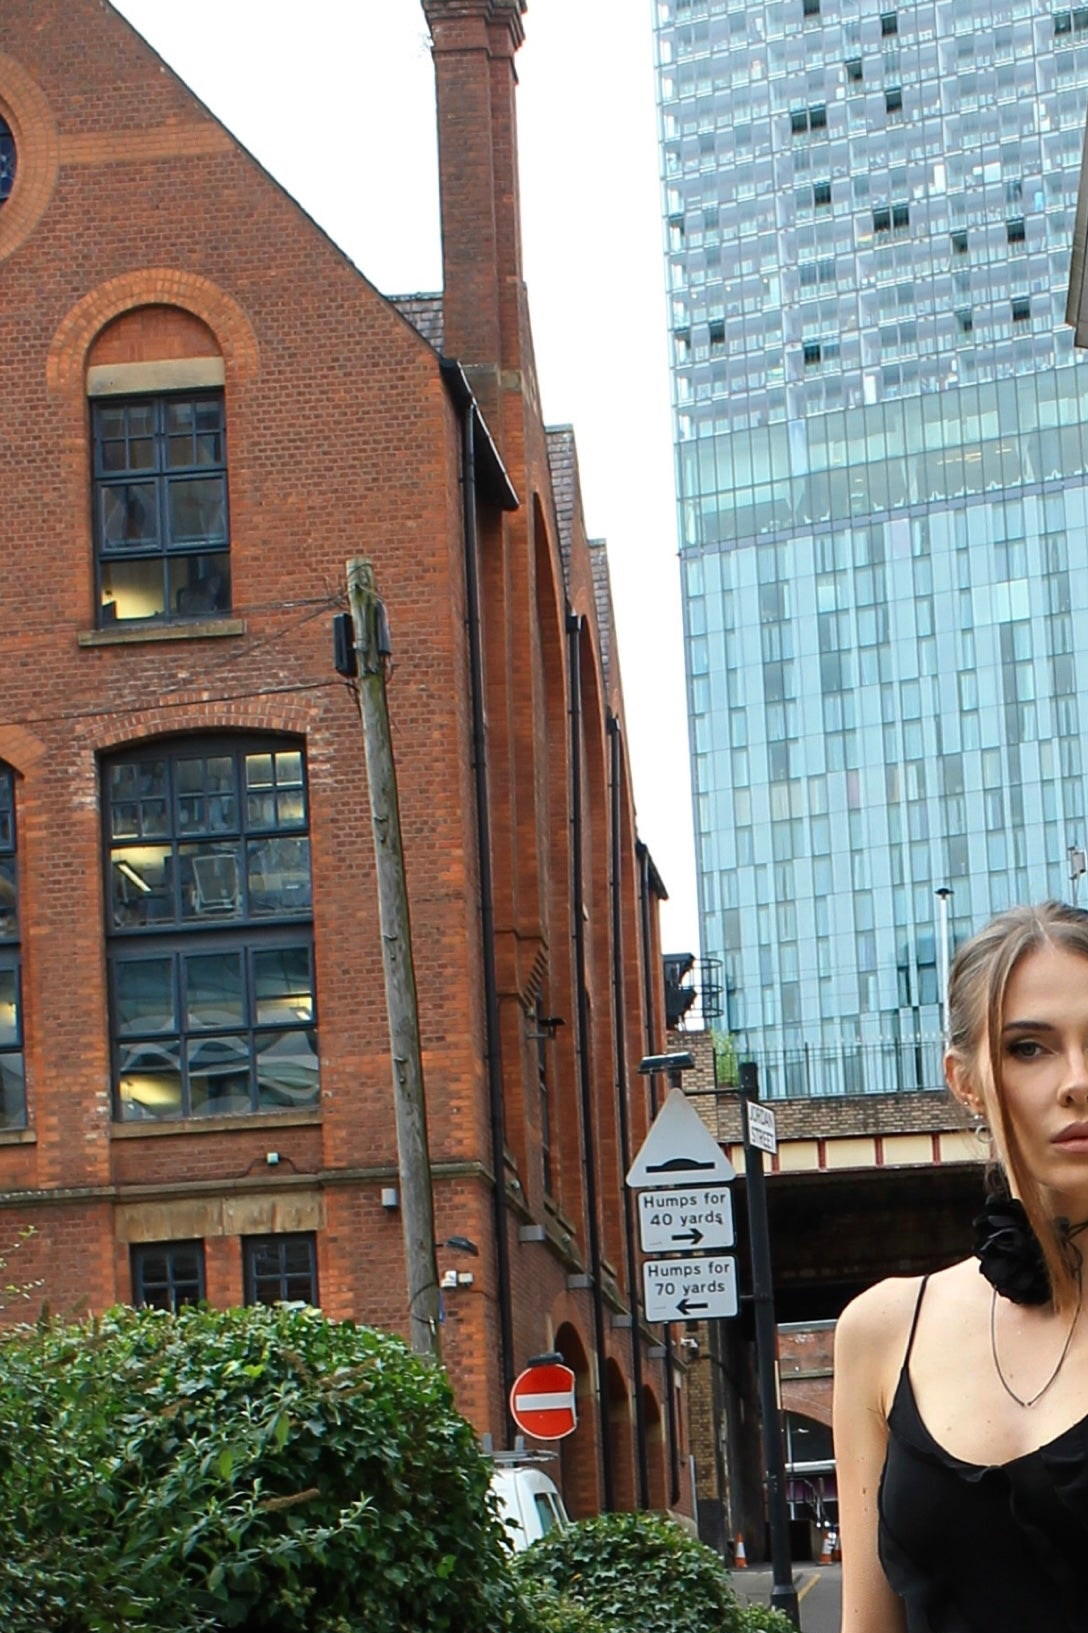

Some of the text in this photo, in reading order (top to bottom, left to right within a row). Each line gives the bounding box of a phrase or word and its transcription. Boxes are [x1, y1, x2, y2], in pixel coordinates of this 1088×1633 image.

[750, 1105, 774, 1128] JORDAN
[751, 1126, 774, 1150] STREET
[643, 1192, 726, 1209] Humps for
[650, 1211, 723, 1227] 40 yards
[647, 1261, 730, 1278] Humps for
[655, 1280, 726, 1296] 70 yards
